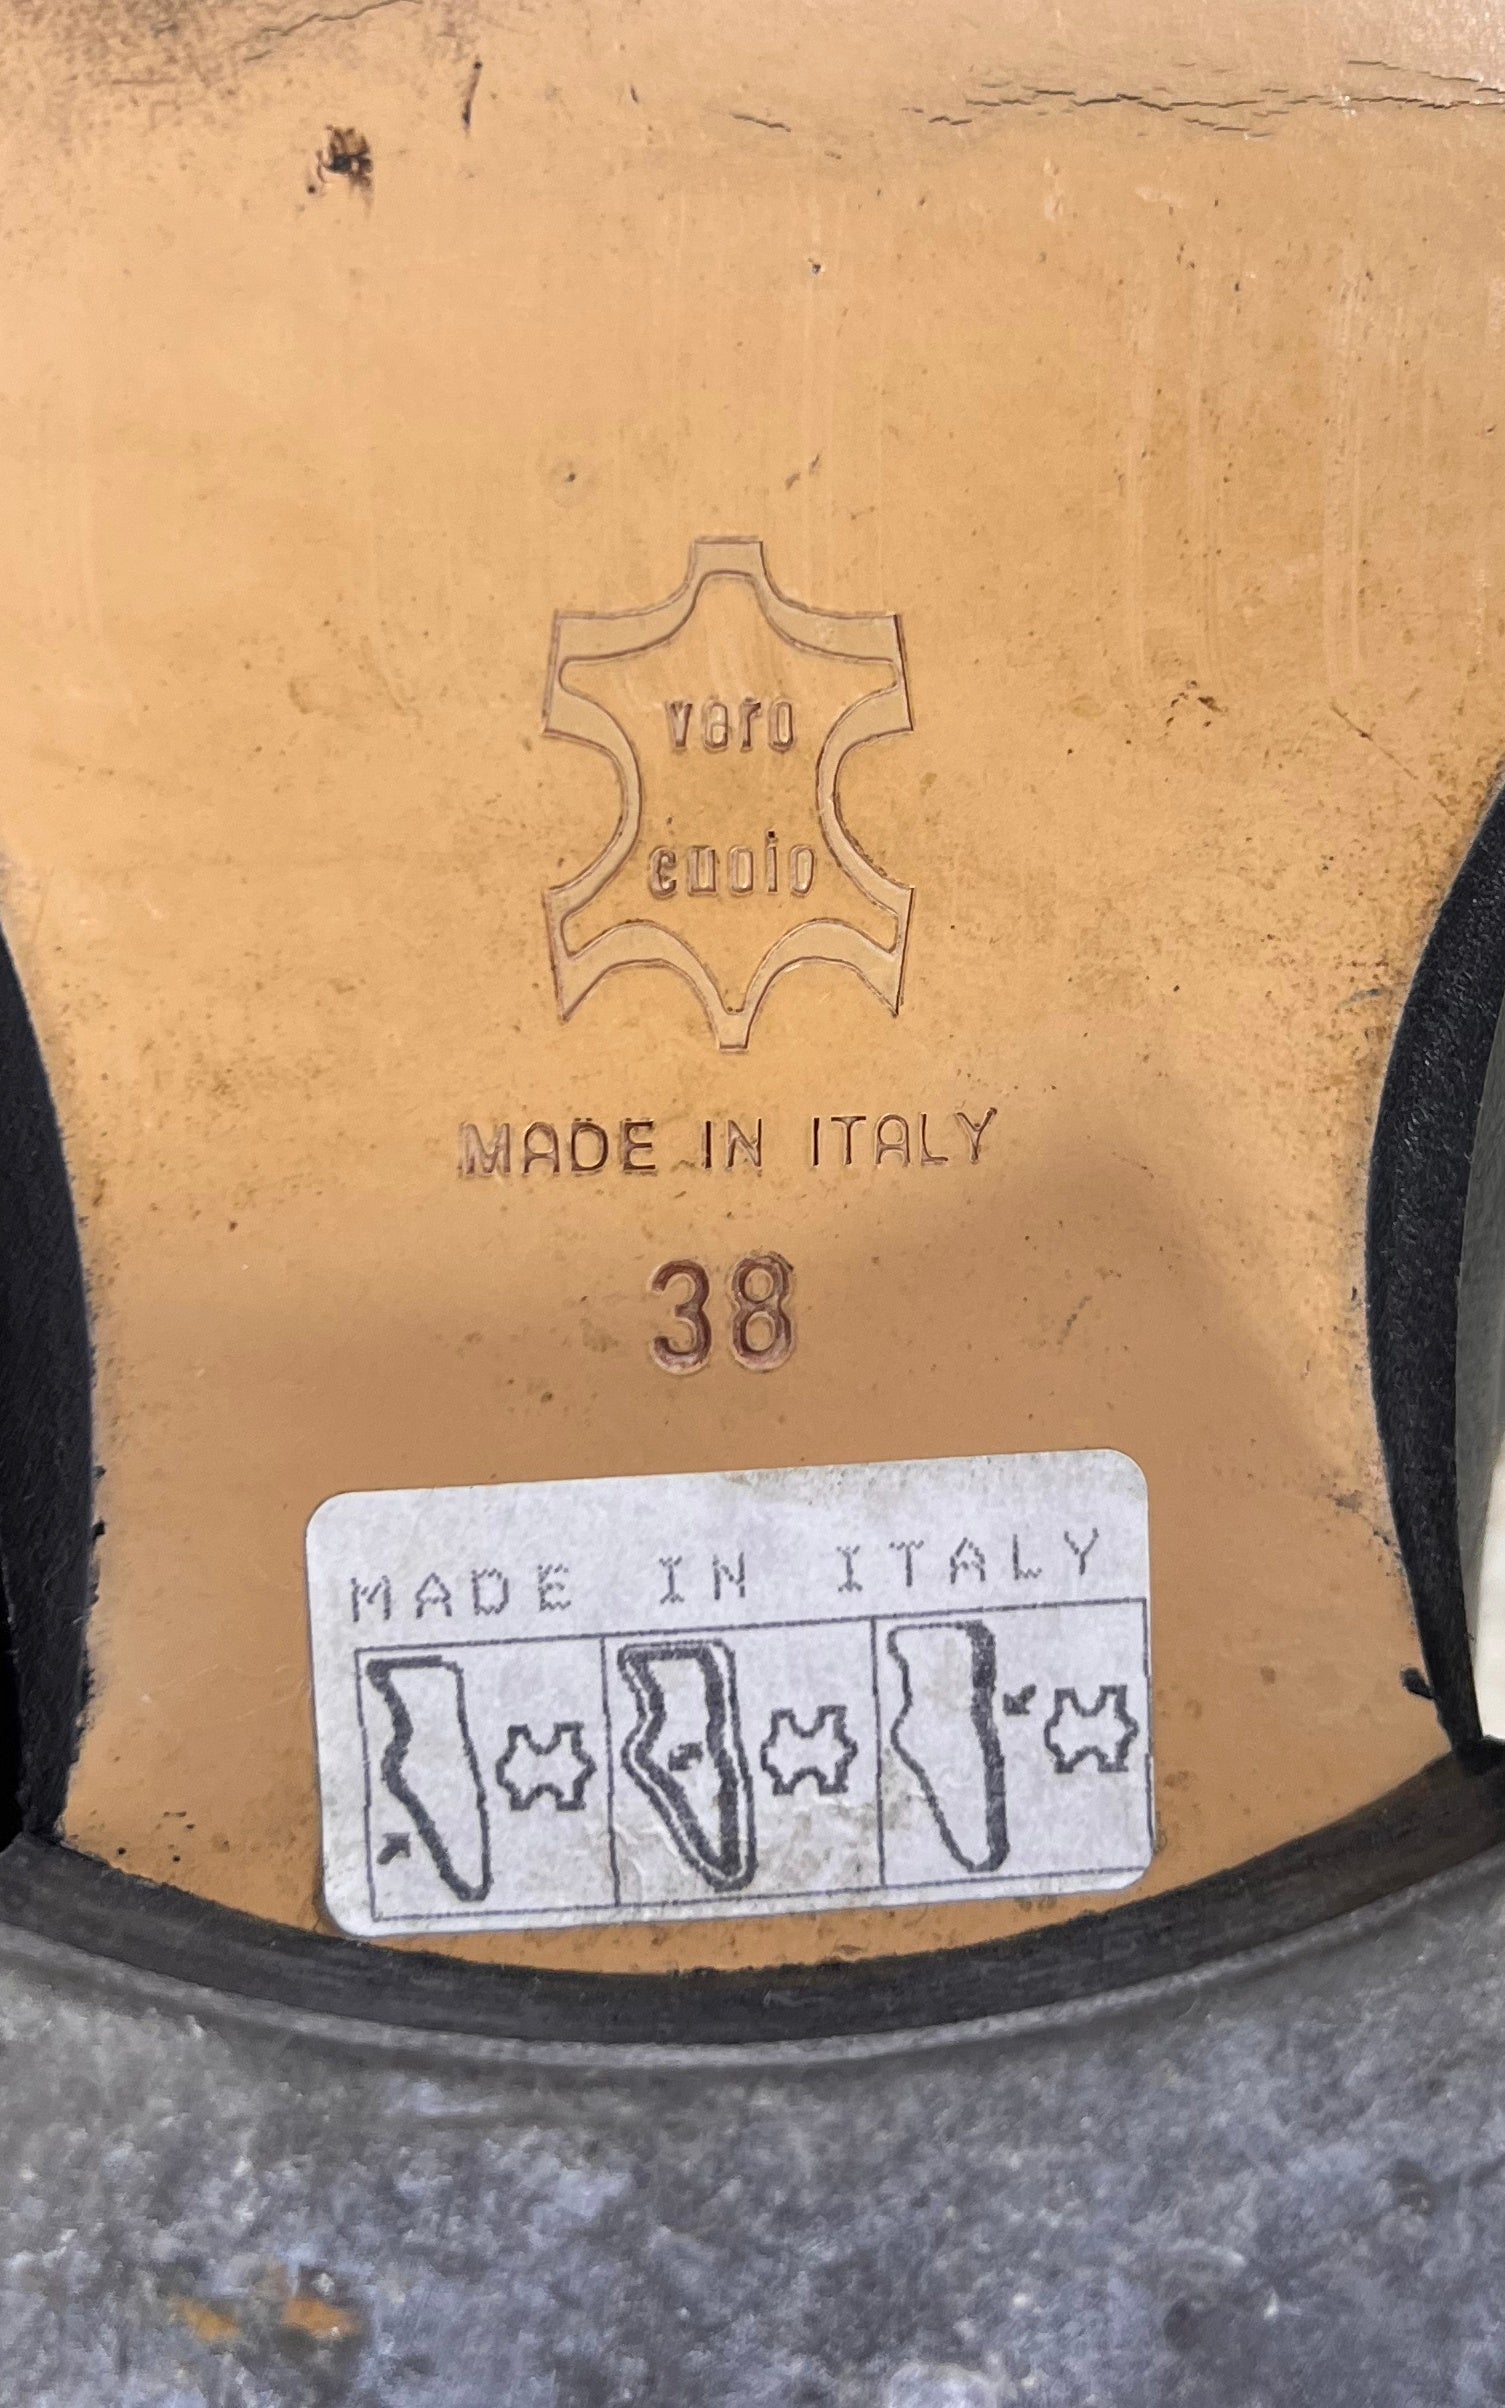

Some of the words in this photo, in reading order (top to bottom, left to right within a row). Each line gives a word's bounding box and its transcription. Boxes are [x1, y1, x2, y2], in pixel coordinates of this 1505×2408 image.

[457, 1119, 655, 1174] MADE
[704, 1118, 763, 1168] IN
[812, 1107, 998, 1167] ITALY
[651, 1256, 793, 1372] 38
[350, 1563, 571, 1622] MADE
[659, 1552, 746, 1603] IN
[836, 1528, 1100, 1593] ITALY
